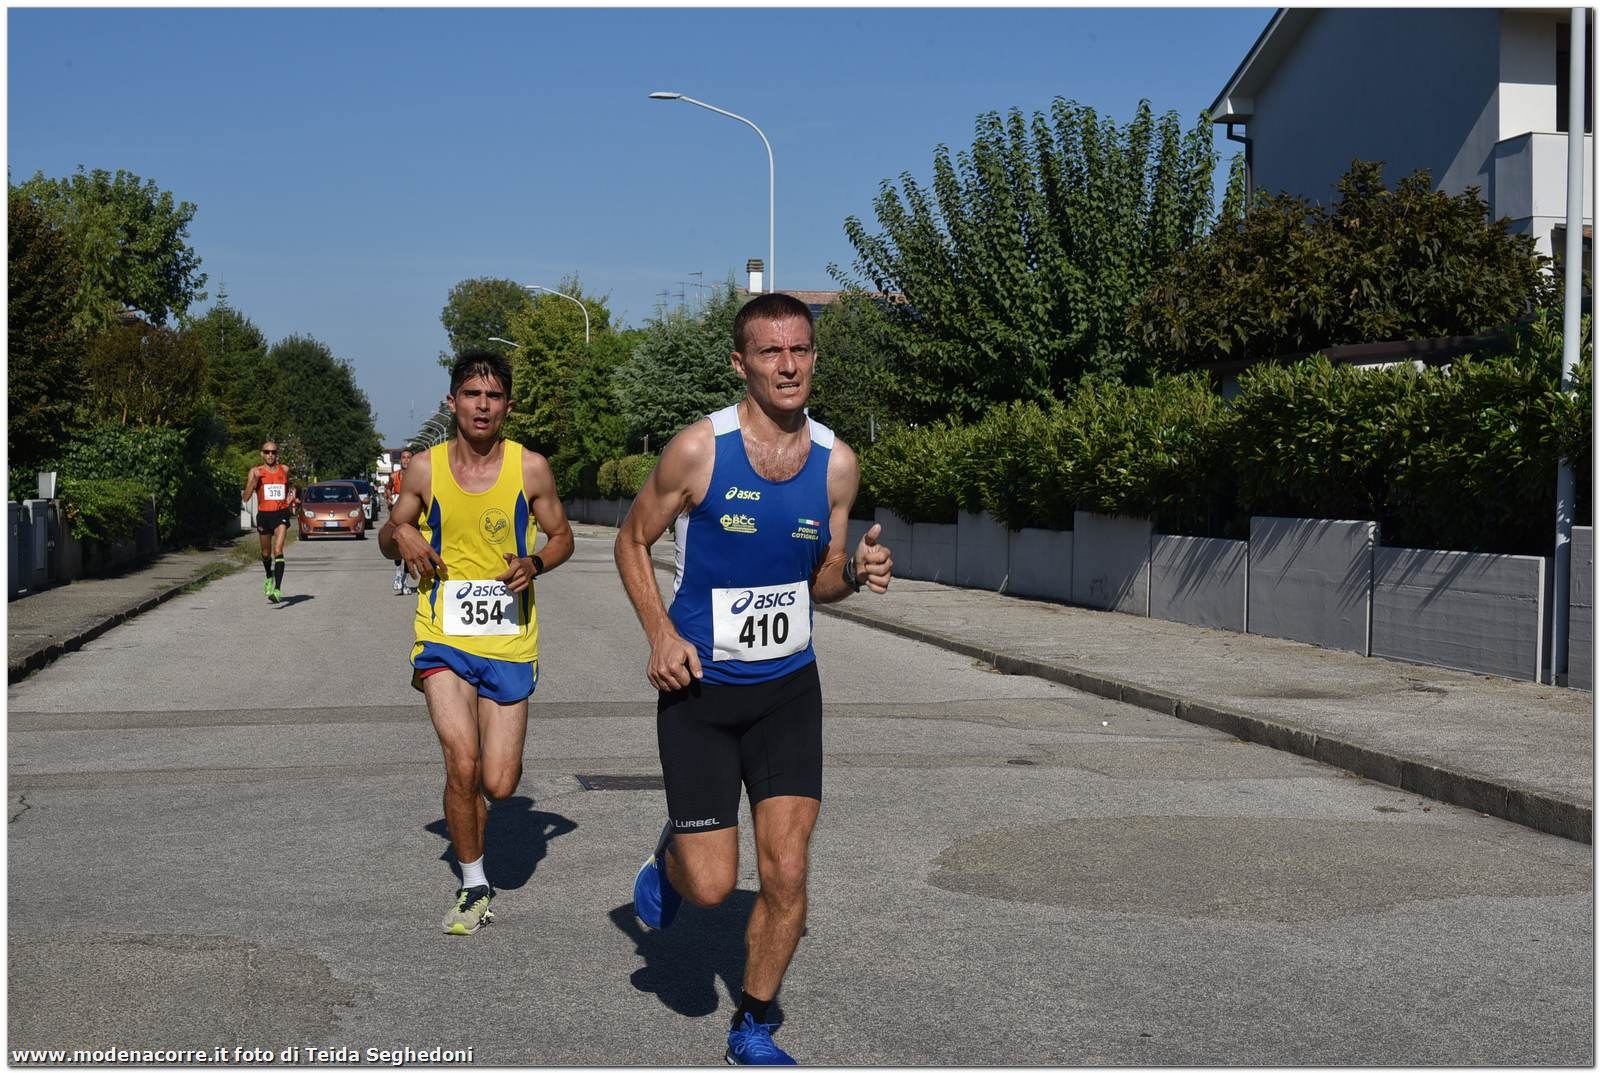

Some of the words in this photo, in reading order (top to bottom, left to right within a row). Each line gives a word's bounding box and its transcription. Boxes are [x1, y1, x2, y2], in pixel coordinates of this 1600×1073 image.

[737, 489, 761, 501] asics
[733, 516, 756, 526] BCC
[473, 584, 507, 597] asics
[754, 590, 796, 610] asics
[460, 600, 503, 625] 354
[739, 612, 789, 648] 410
[675, 817, 720, 828] LURBEL
